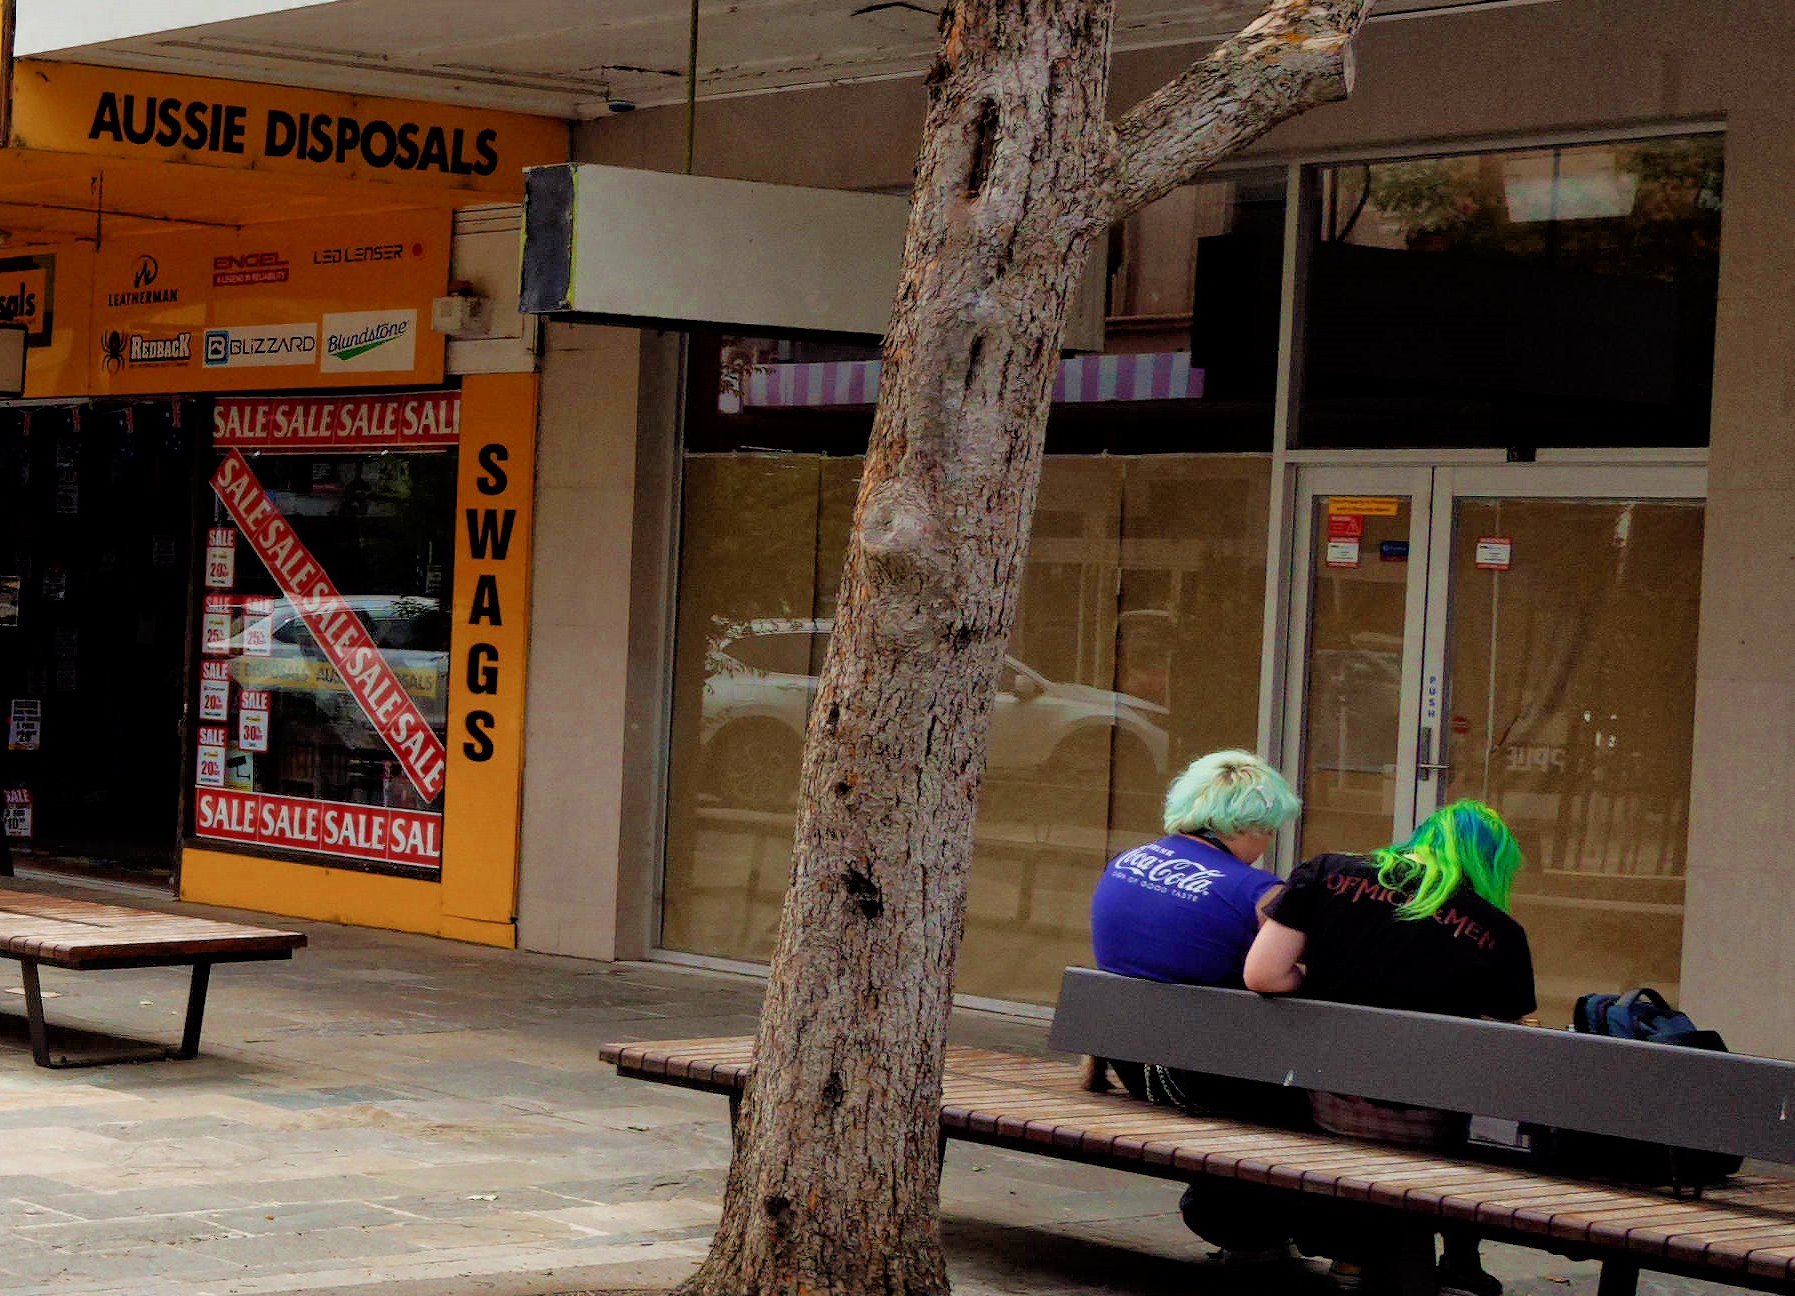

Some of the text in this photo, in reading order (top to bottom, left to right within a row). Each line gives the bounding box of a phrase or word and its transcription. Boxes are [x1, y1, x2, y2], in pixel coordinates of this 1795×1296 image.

[89, 92, 499, 177] AUSSIE DISPOSALS
[108, 288, 178, 307] LEATHERMAN
[327, 320, 409, 354] Blundstone
[212, 405, 269, 438] SALE
[273, 404, 335, 438] SALE
[337, 403, 399, 437] SALE
[208, 529, 234, 547] SALE
[463, 443, 516, 762] SWAGS
[218, 458, 444, 792] SALE SALE SALE SALE SALE
[203, 663, 229, 680] SALE
[241, 692, 268, 709] SALE
[199, 728, 225, 745] SALE
[199, 796, 440, 855] SALE SALE SALE SAL
[1115, 843, 1227, 893] Coca-Cola
